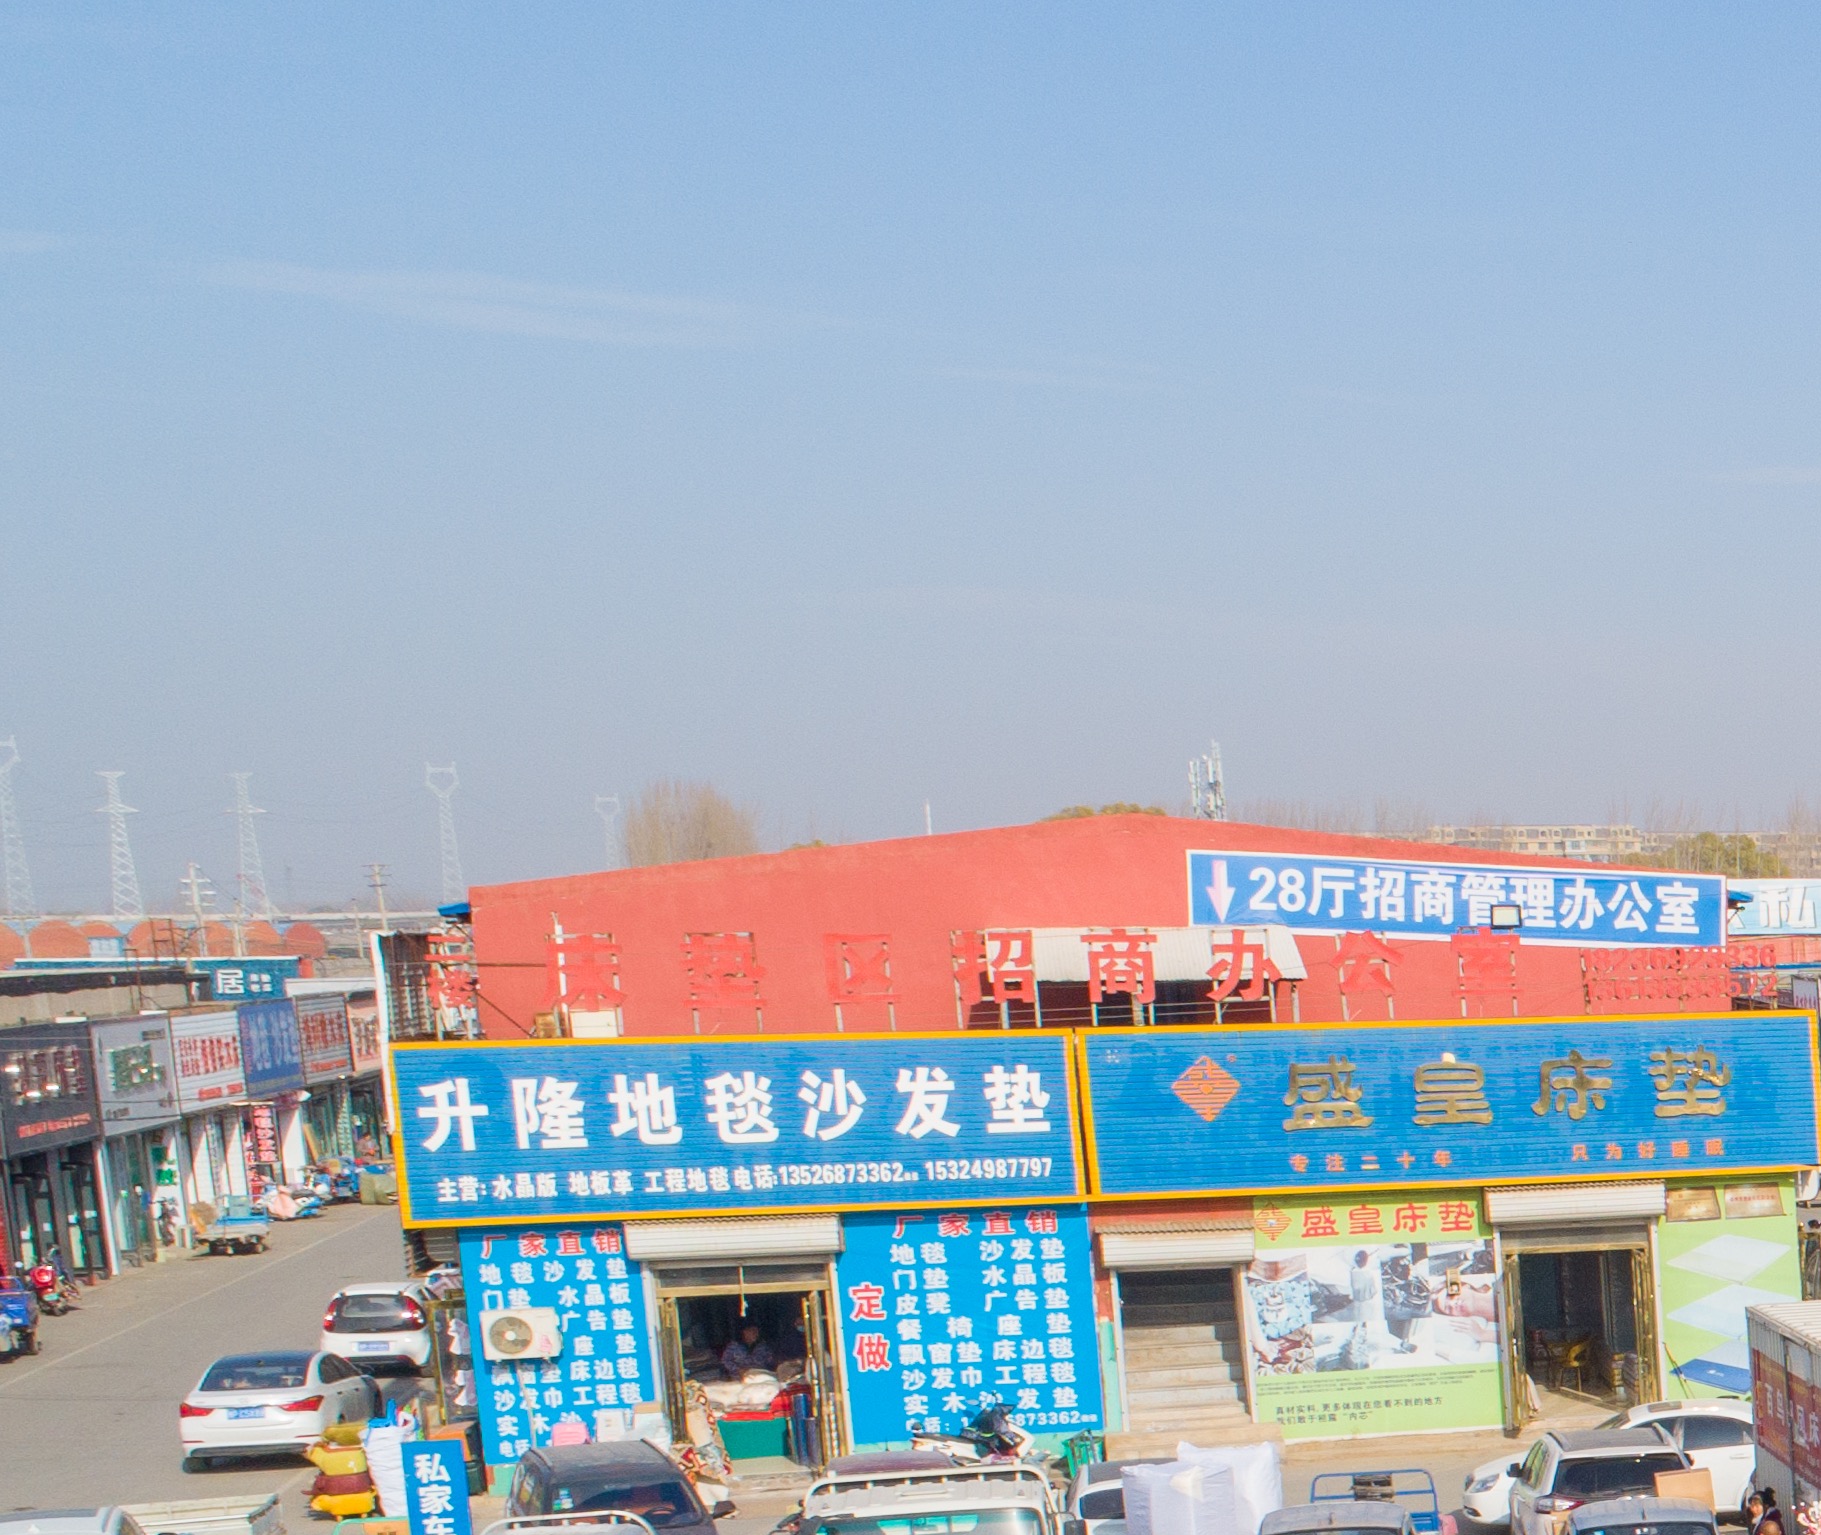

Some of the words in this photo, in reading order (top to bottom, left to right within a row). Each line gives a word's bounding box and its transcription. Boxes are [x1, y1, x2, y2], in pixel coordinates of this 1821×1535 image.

[1247, 866, 1700, 935] 28厅招商管理办公室
[1283, 1043, 1733, 1132] 盛皇床垫
[417, 1063, 1051, 1152] 升隆地毯沙发垫
[1289, 1149, 1453, 1173] 专注二十年
[1571, 1137, 1724, 1162] 只为好睡眠
[437, 1176, 488, 1203] 主营:
[492, 1171, 558, 1200] 水晶版
[569, 1170, 633, 1197] 地板革
[644, 1165, 730, 1194] 工程地毯
[924, 1157, 1052, 1182] 15324987797
[892, 1209, 1059, 1239] 厂家直销
[1300, 1200, 1476, 1239] 盛皇床垫
[481, 1228, 623, 1259] 厂家直销
[890, 1241, 948, 1266] 地毯
[979, 1237, 1066, 1263] 沙发垫
[479, 1257, 629, 1286] 地毯沙发垫
[892, 1267, 950, 1291] 门垫
[982, 1262, 1068, 1287] 水晶板
[482, 1287, 532, 1309] 门垫
[557, 1283, 632, 1307] 水晶板
[895, 1291, 951, 1316] 皮凳
[984, 1287, 1070, 1312] 广告垫
[561, 1308, 635, 1333] 广告垫
[849, 1282, 892, 1373] 定做
[898, 1341, 983, 1366] 飘窗垫
[992, 1337, 1075, 1362] 床边毯
[569, 1356, 640, 1381] 床边毯
[901, 1367, 983, 1391] 沙发巾
[995, 1361, 1076, 1385] 工程毯
[493, 1387, 564, 1412] 沙发巾
[572, 1381, 643, 1406] 工程毯
